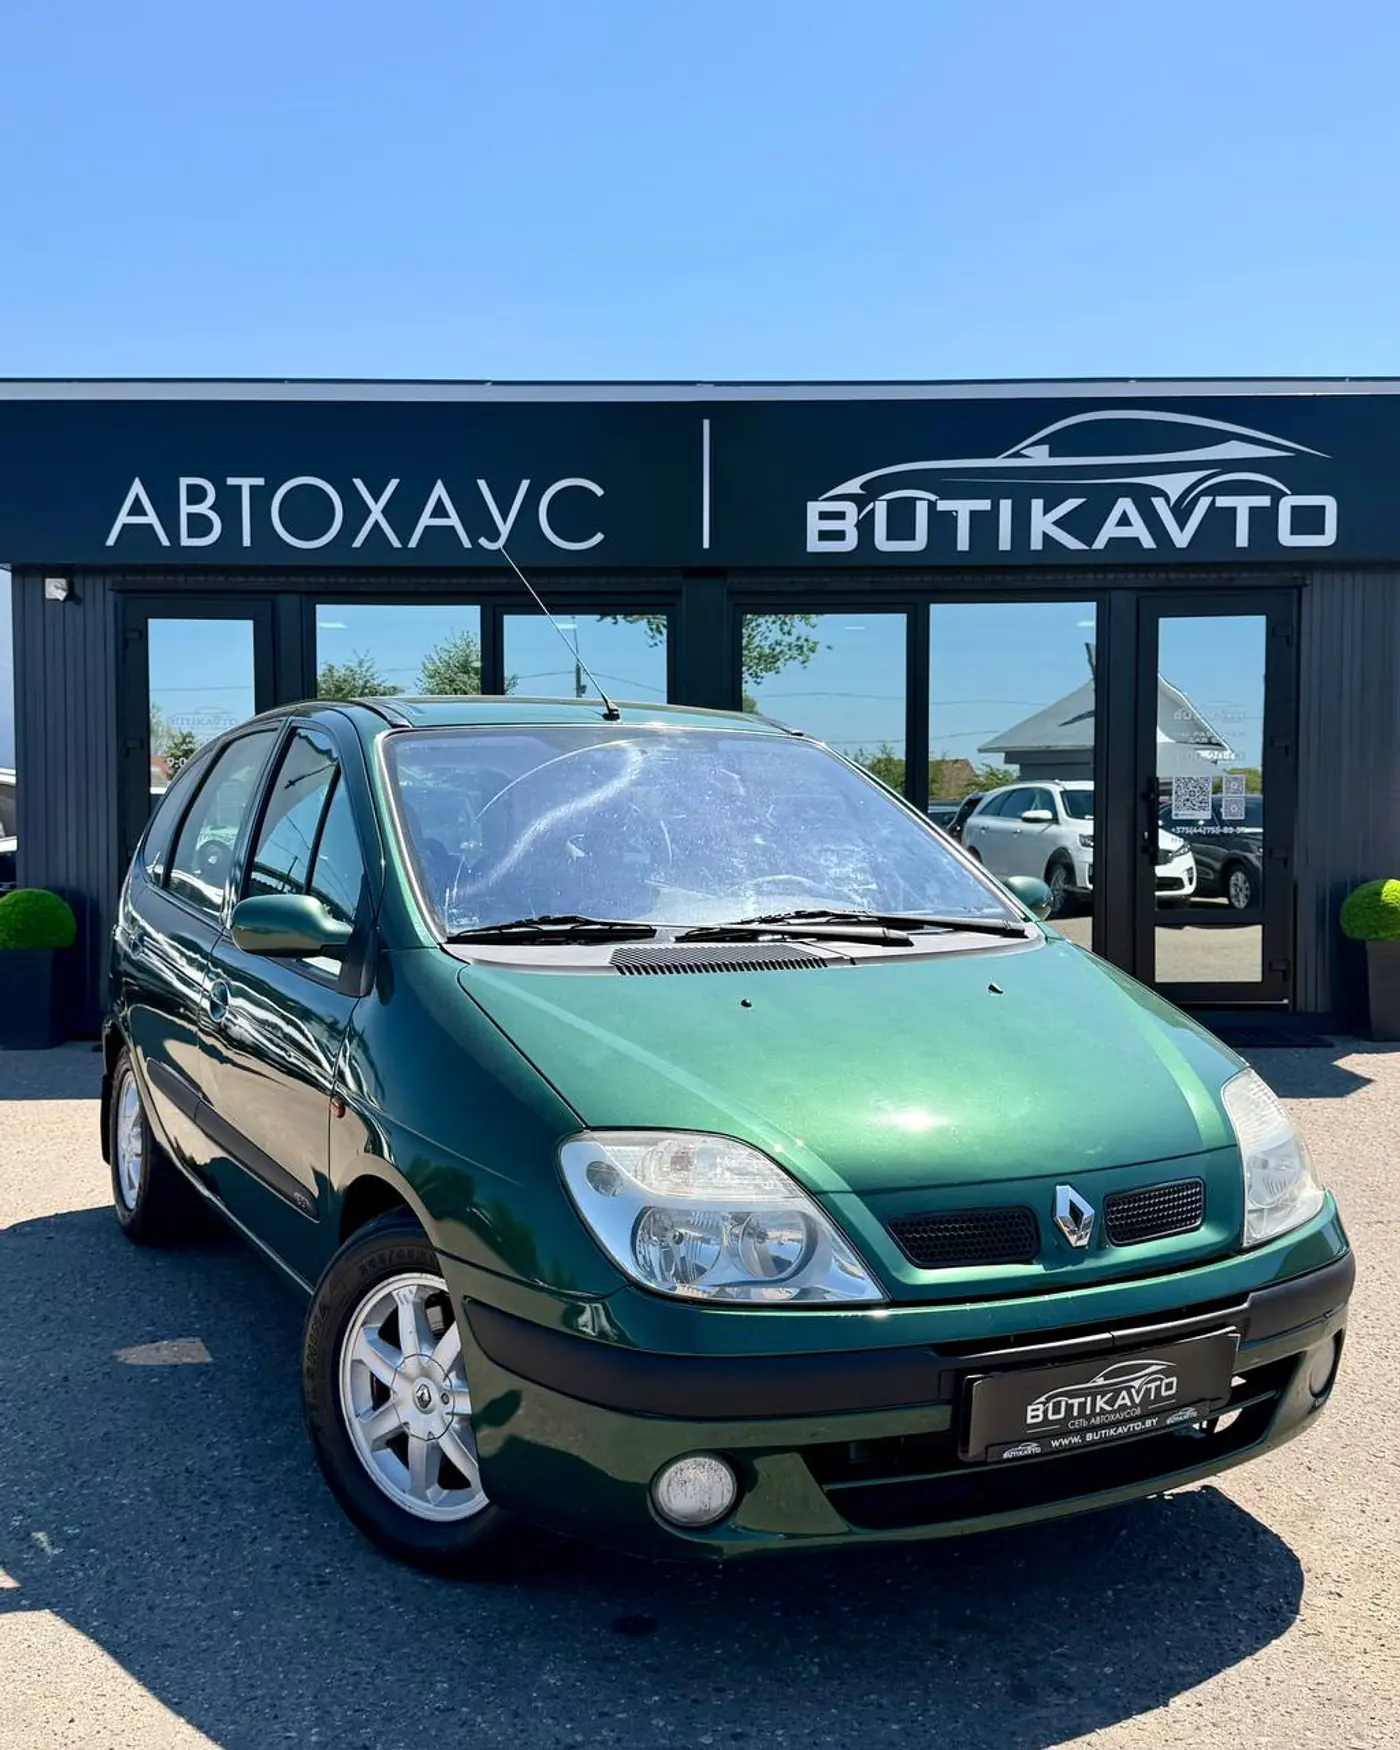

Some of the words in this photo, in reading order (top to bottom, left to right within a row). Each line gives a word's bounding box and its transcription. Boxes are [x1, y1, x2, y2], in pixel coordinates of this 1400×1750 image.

[105, 475, 606, 551] АВТОХАУС
[806, 494, 1338, 553] BUTIKAVTO
[1026, 1376, 1178, 1424] BUTIKAVTO
[1090, 1407, 1142, 1425] АВТОХАУСОВ
